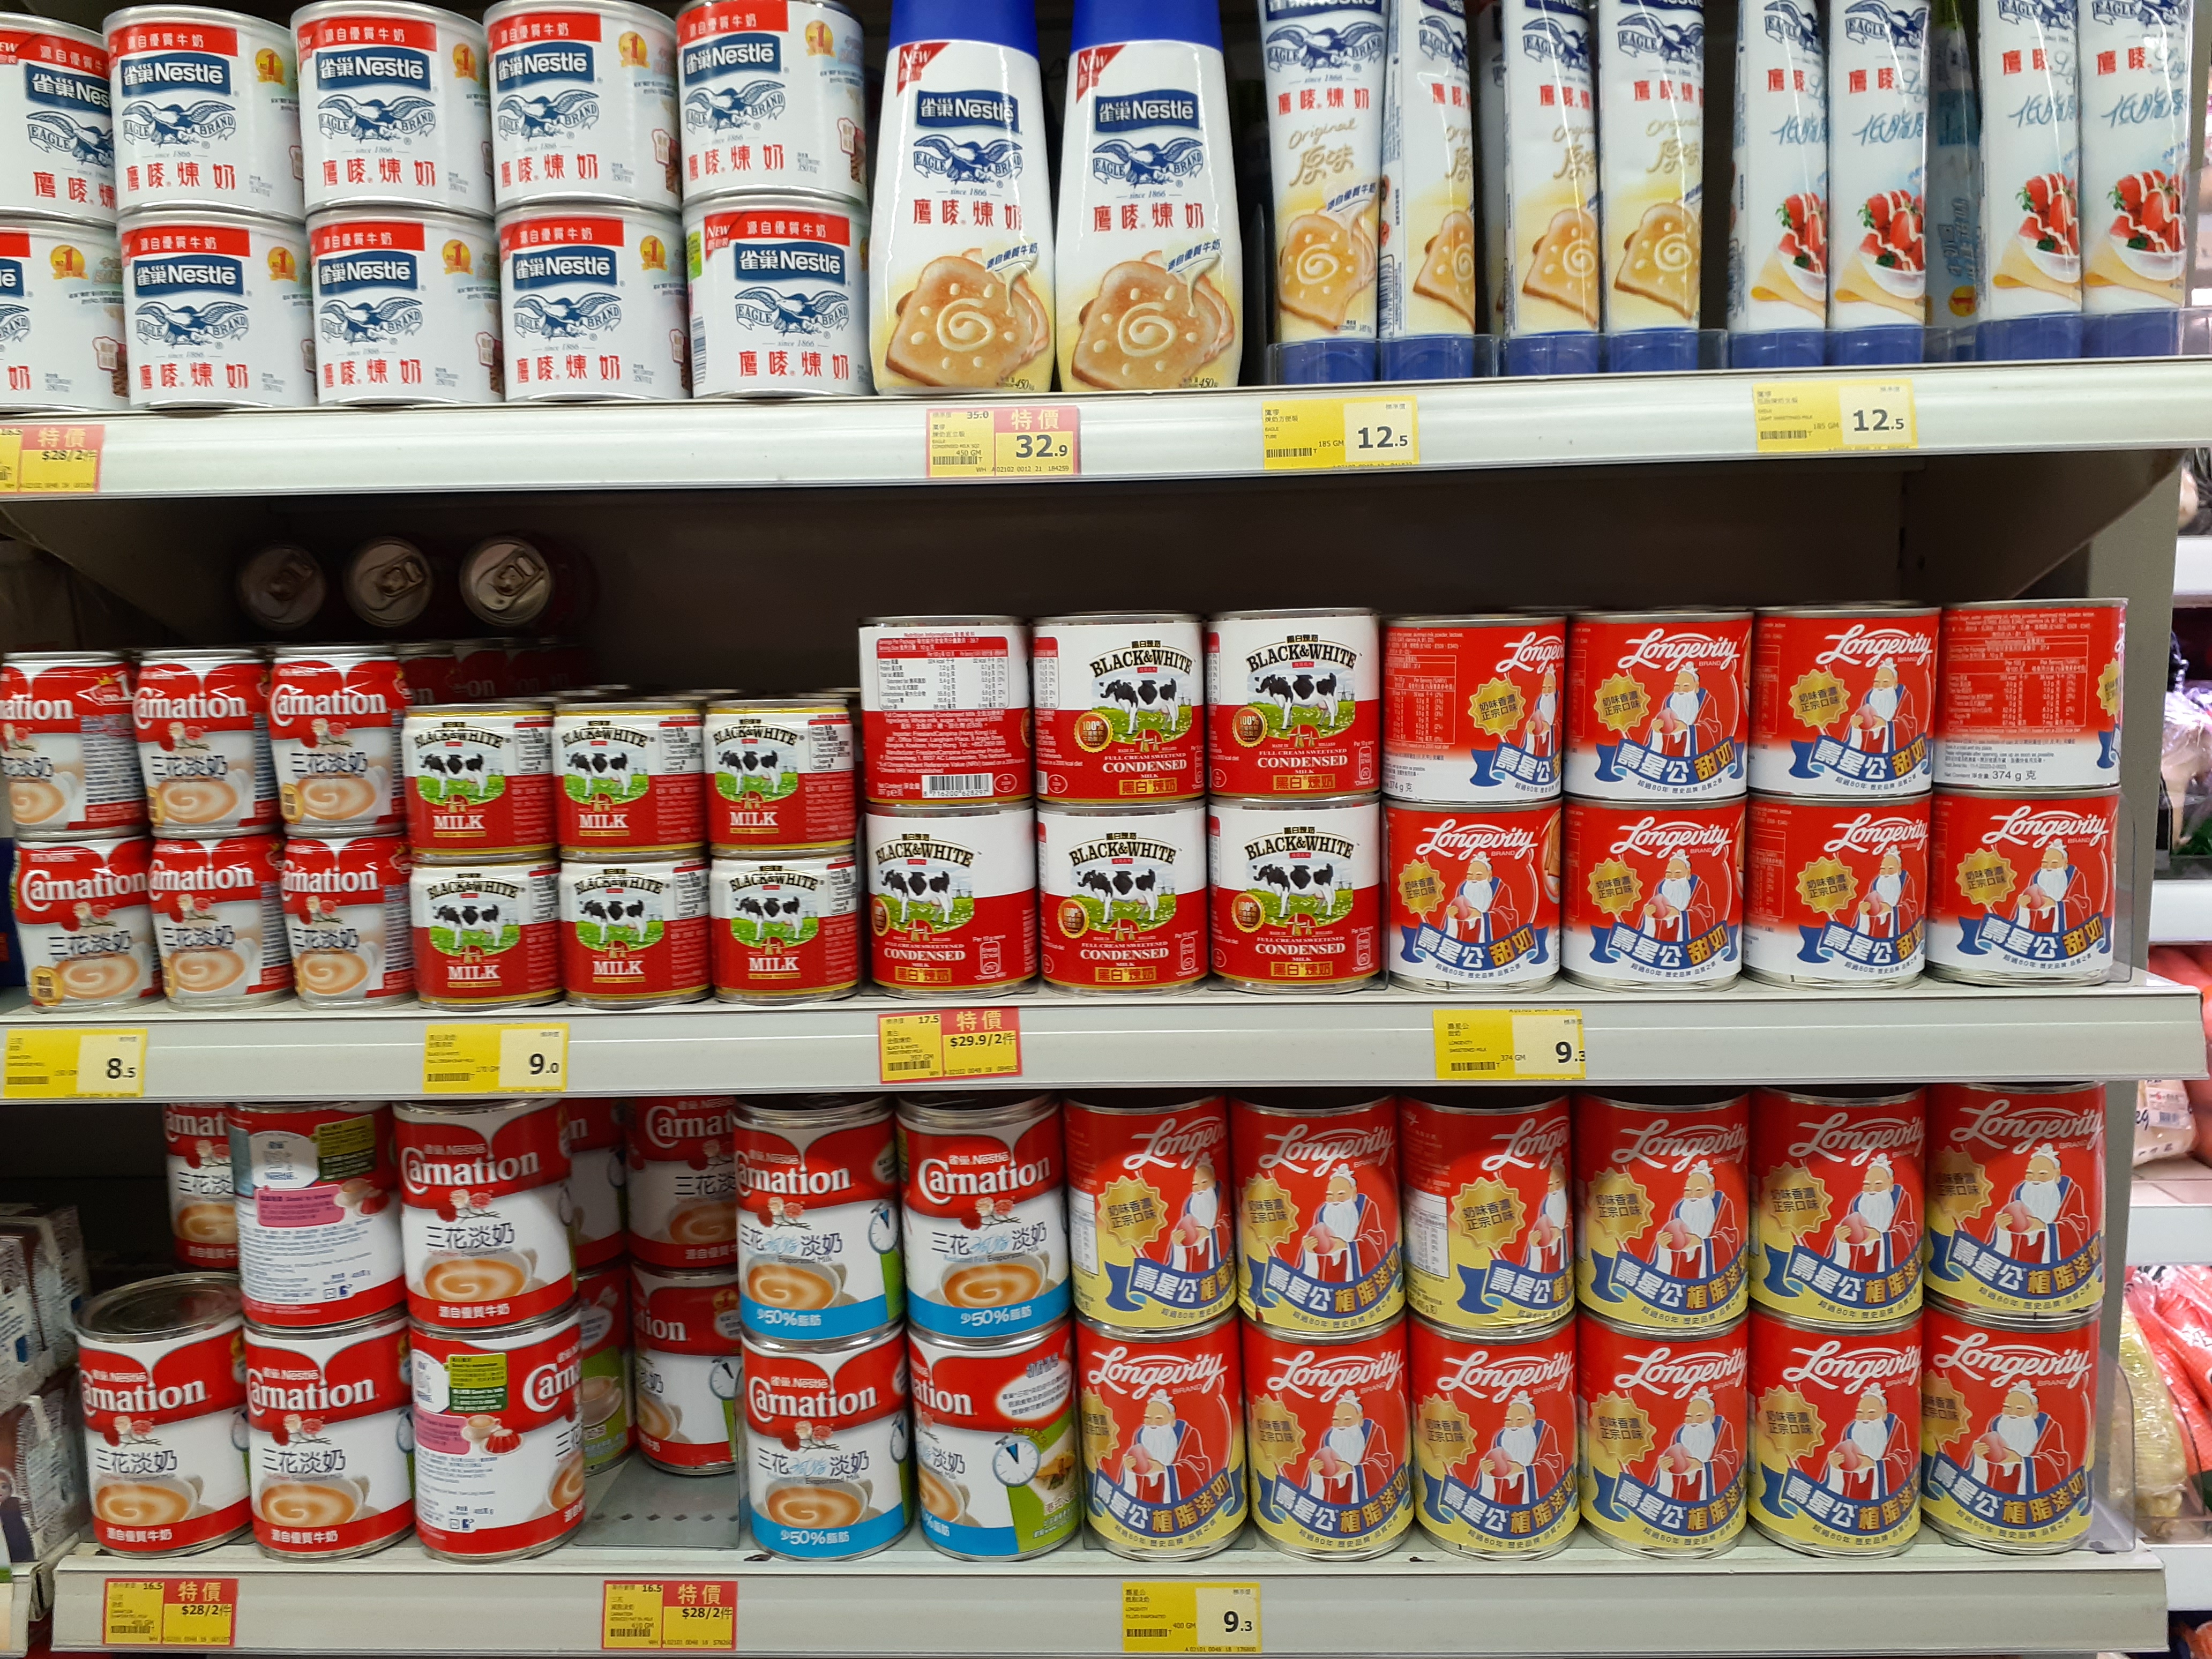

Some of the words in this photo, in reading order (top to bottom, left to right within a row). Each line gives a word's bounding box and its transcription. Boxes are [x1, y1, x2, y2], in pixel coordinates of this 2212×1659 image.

[1267, 48, 1299, 63] EAGLE
[31, 123, 71, 150] EAGLE
[1288, 117, 1358, 148] Original
[914, 153, 946, 172] EAGLE
[1095, 158, 1125, 177] EAGLE
[1174, 153, 1201, 172] BRAND
[968, 188, 987, 197] 1866
[706, 225, 731, 243] NEW
[737, 306, 772, 323] EAGLE
[822, 305, 848, 326] BRAND
[796, 340, 815, 348] 1866
[1011, 409, 1059, 430] 特價
[1853, 409, 1904, 431] 12.5
[38, 428, 86, 447] 特價
[1015, 435, 1068, 458] 32.9
[1358, 426, 1408, 448] 12.5
[1618, 628, 1740, 672] Longevity
[134, 686, 248, 729] Carnation
[1103, 759, 1187, 774] CONDENSED
[1257, 755, 1348, 768] CONDENSED
[1992, 770, 2012, 780] 374
[2015, 773, 2021, 782] g
[2025, 770, 2036, 780] 克
[433, 814, 485, 829] MILK
[579, 814, 629, 828] MILK
[730, 811, 778, 826] MILK
[1982, 806, 2108, 849] Longevity
[1416, 819, 1538, 860] Longevity
[1825, 813, 1929, 855] Longevity
[21, 869, 147, 912] Carnation
[282, 860, 378, 902] Carnation
[884, 947, 966, 961] CONDENSED
[1080, 947, 1169, 961] CONDENSED
[1255, 943, 1346, 955] CONDENSED
[447, 966, 500, 980] MILK
[593, 961, 644, 975] MILK
[749, 957, 799, 971] MILK
[918, 1015, 938, 1023] 17.5
[956, 1011, 1003, 1031] 特價
[107, 1058, 136, 1079] 8.5
[529, 1053, 559, 1074] 9.0
[1951, 1100, 2104, 1154] Longevity
[1612, 1119, 1746, 1173] Longevity
[1788, 1113, 1924, 1167] Longevity
[401, 1147, 538, 1194] Carnation
[734, 1150, 850, 1197] Carnation
[918, 1156, 1049, 1205] Carnation
[426, 1223, 515, 1250] 三花淡奶
[1934, 1333, 2092, 1388] Longevity
[1437, 1351, 1573, 1403] Longevity
[1615, 1347, 1747, 1400] Longevity
[81, 1370, 206, 1417] Carnation
[246, 1368, 375, 1416] Carnation
[750, 1377, 877, 1422] Carnation
[1172, 1384, 1201, 1394] BRAND
[96, 1449, 177, 1474] 三花淡奶
[263, 1449, 345, 1473] 三花淡奶
[178, 1581, 221, 1602] 特價
[678, 1584, 721, 1605] 特價
[1224, 1611, 1252, 1632] 9.3
